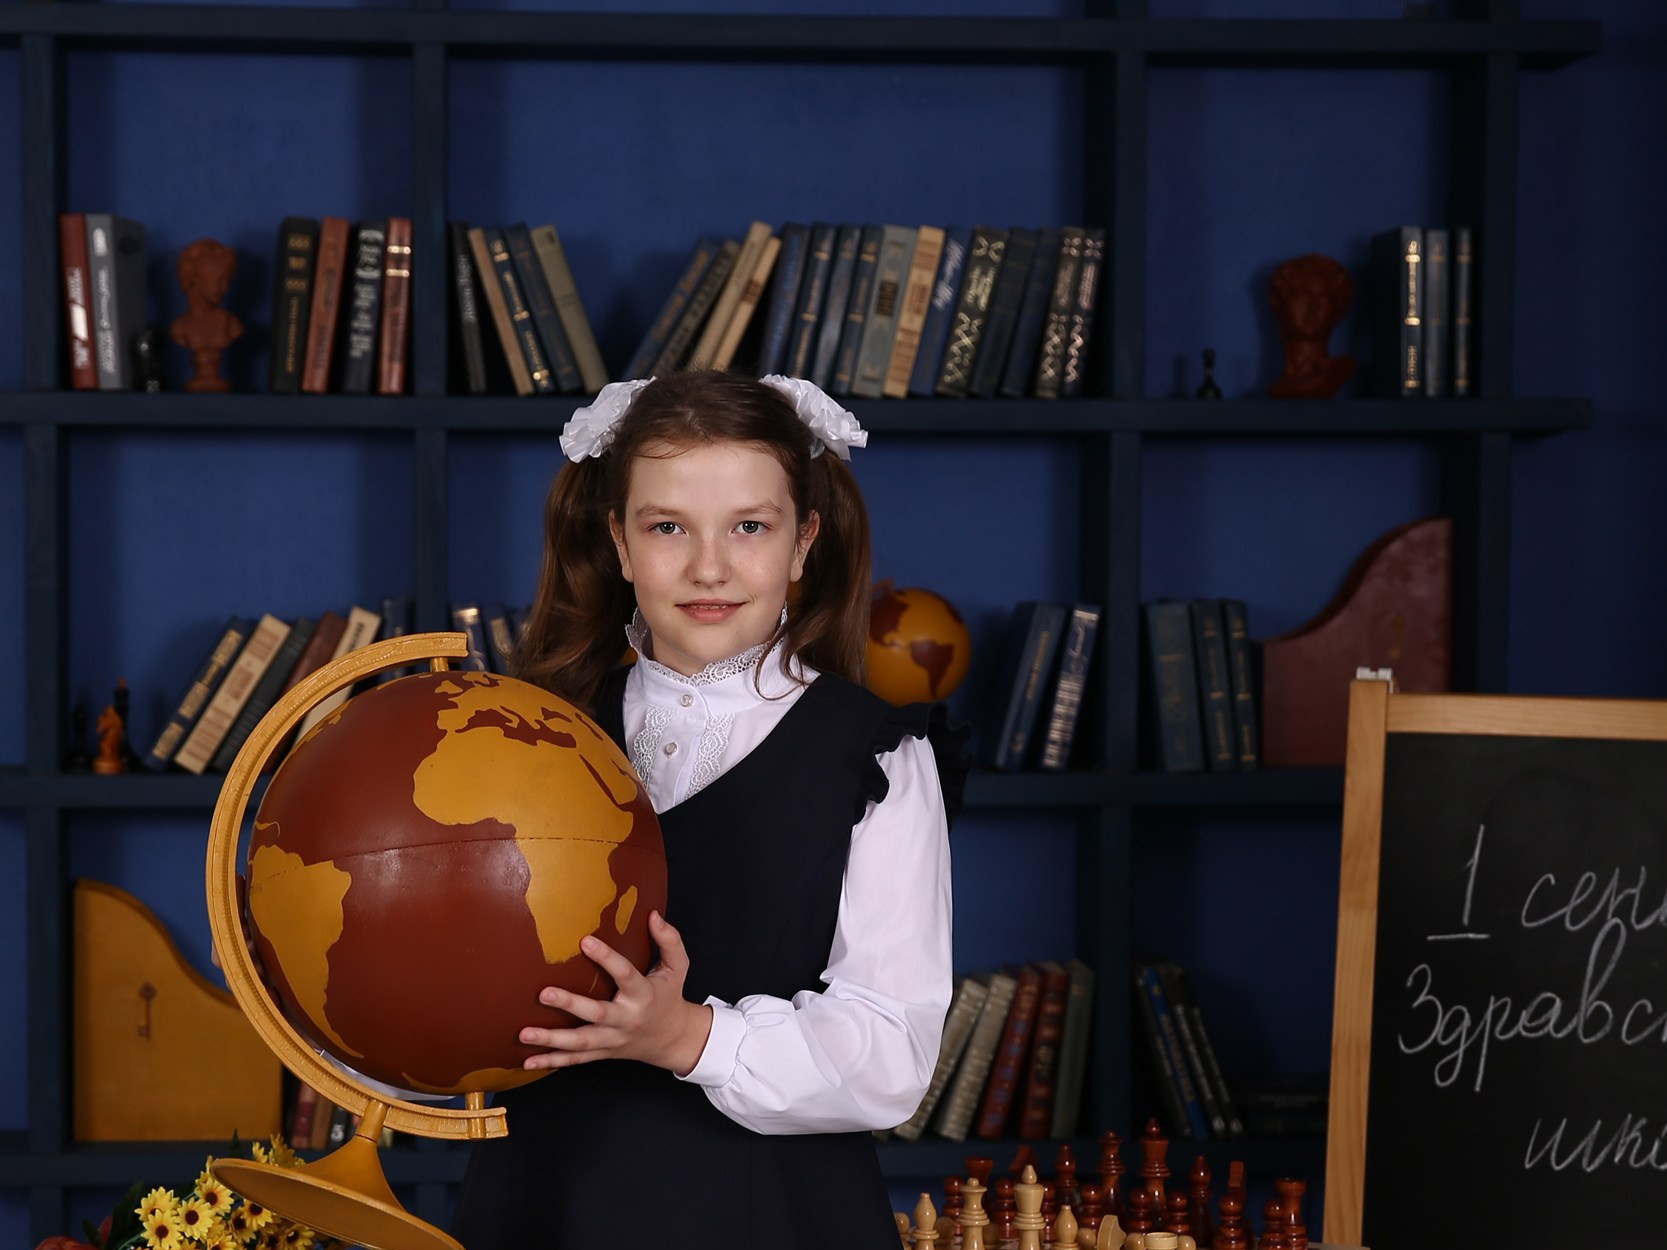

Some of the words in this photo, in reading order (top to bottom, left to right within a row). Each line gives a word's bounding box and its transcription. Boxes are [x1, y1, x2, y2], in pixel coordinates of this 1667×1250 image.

[1427, 823, 1490, 940] 1
[1521, 865, 1667, 931] сен
[1399, 917, 1667, 1092] Здравс
